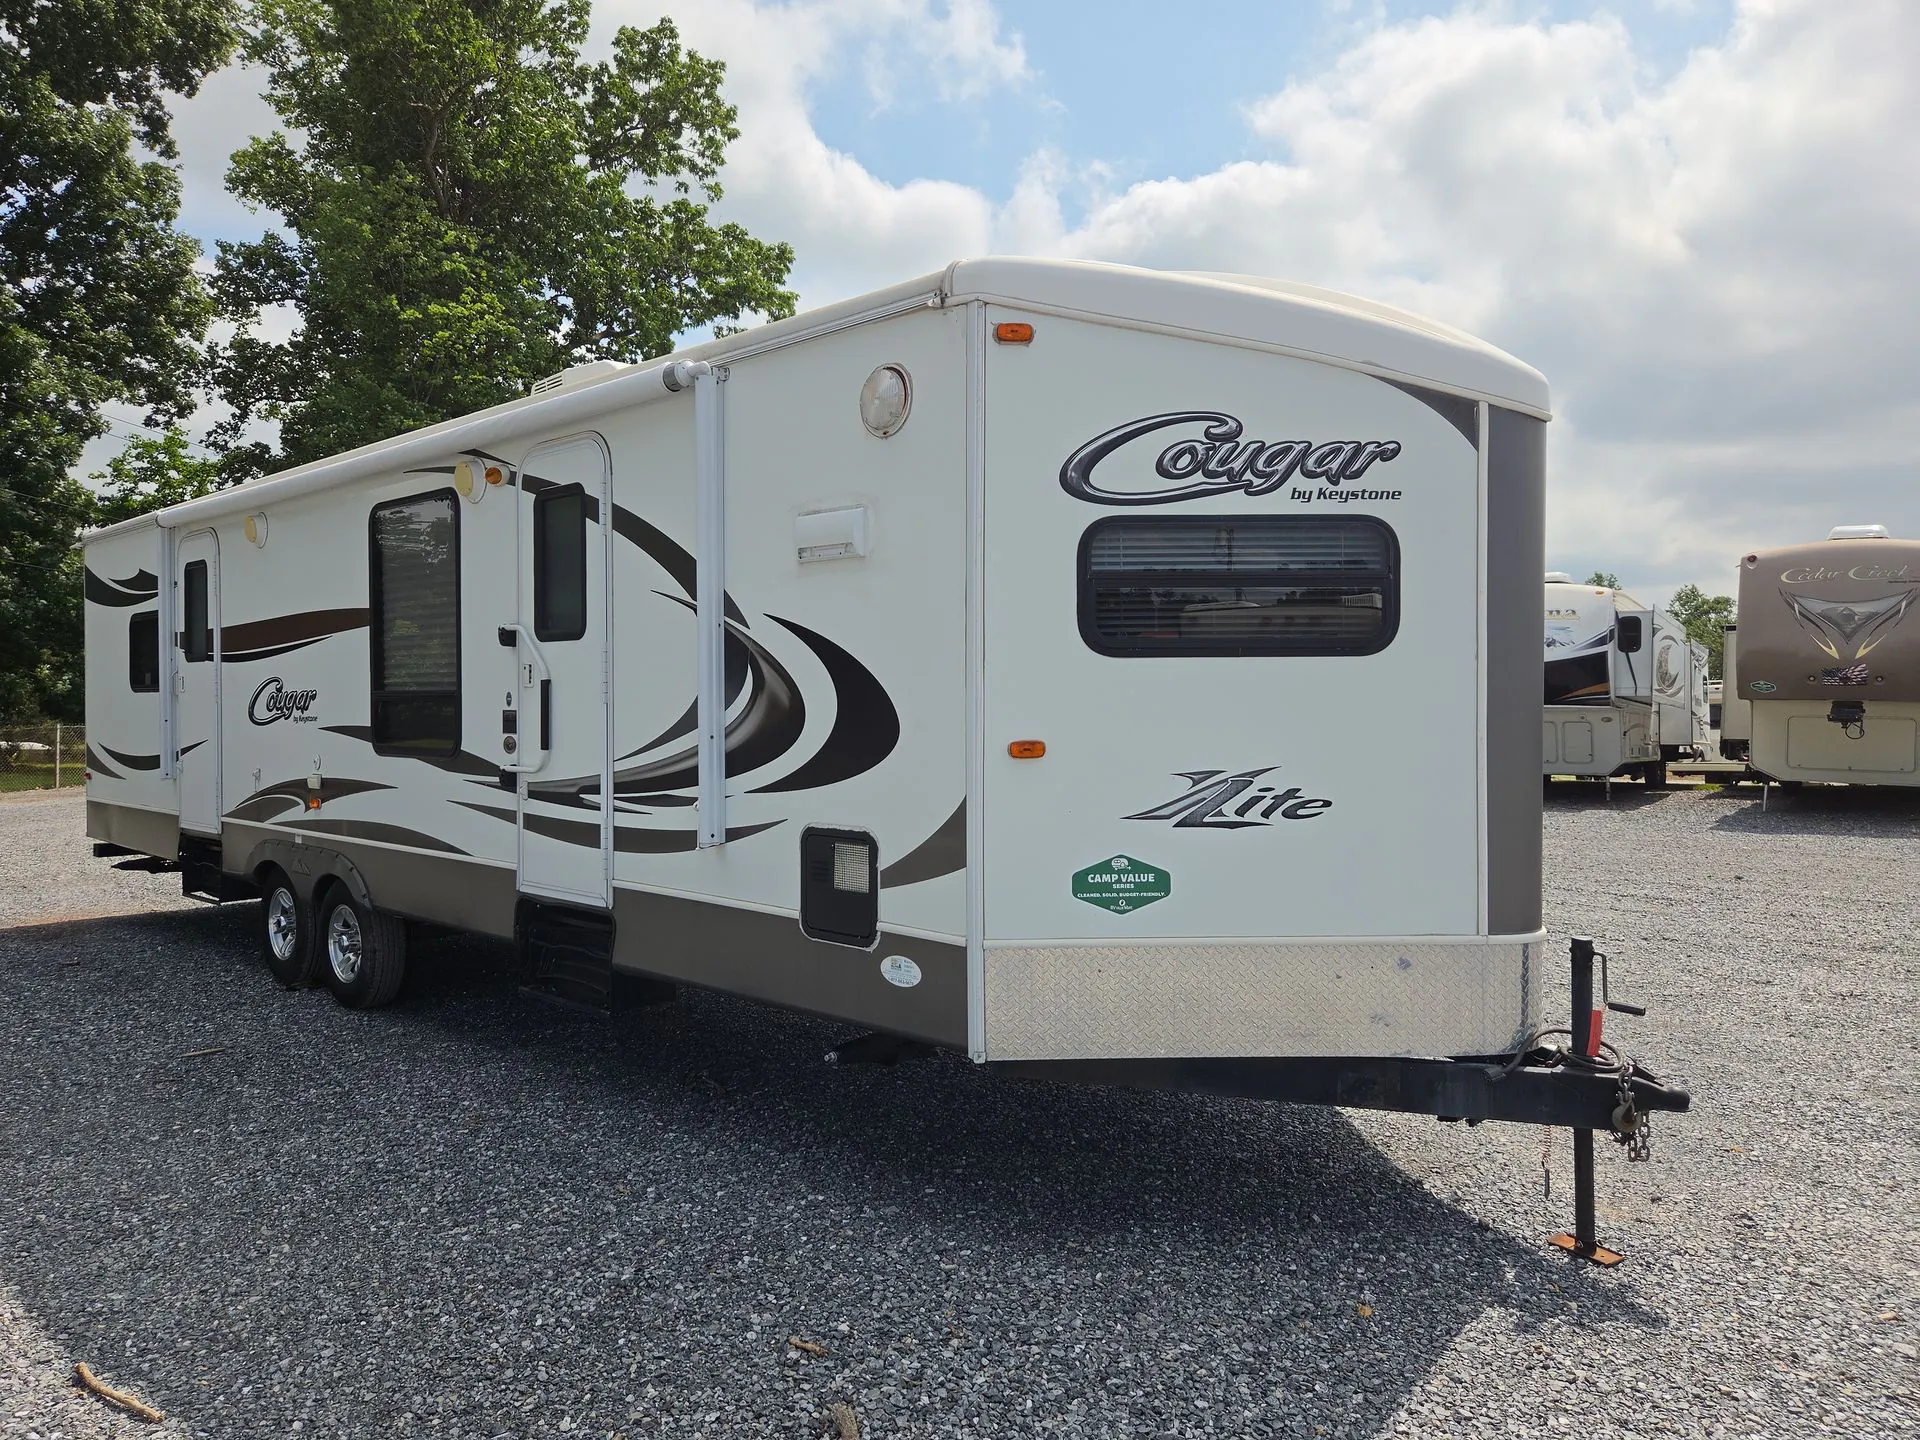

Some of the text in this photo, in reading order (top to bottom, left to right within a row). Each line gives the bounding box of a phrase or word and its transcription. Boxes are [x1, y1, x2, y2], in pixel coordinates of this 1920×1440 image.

[1059, 411, 1402, 506] Cougar
[1291, 487, 1402, 504] by Keystone
[1780, 565, 1908, 584] Cedar Creek
[248, 676, 318, 726] Cougar
[1087, 873, 1155, 883] CAMP VALUE
